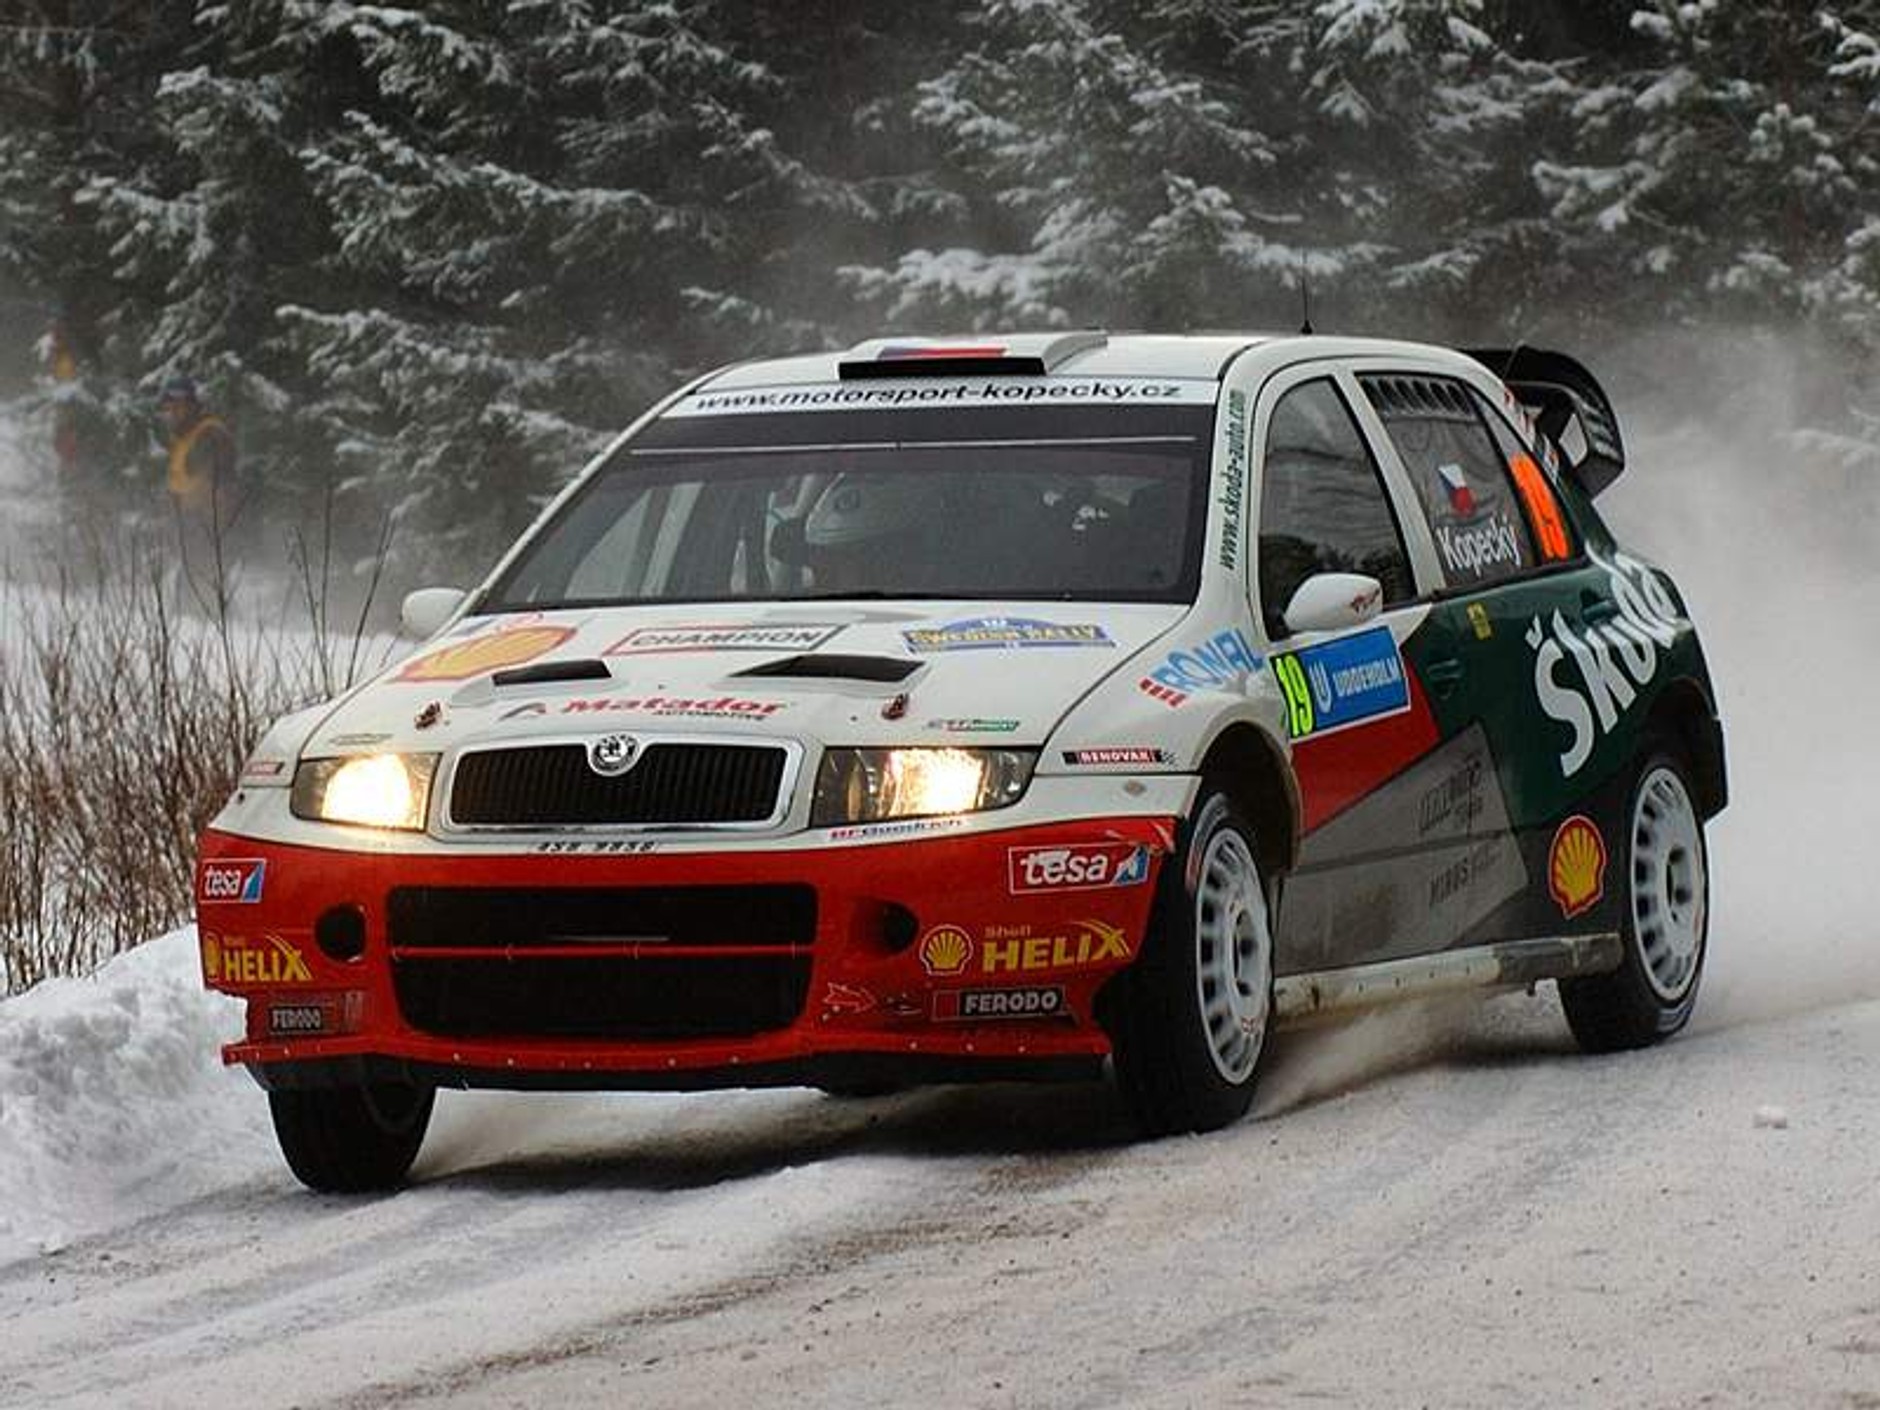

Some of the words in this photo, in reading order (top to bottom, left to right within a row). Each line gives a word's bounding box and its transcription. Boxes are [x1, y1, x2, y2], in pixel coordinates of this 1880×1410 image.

[696, 381, 1182, 410] www.motorsport-kopecky.cz
[632, 631, 821, 647] CHAMPION
[562, 698, 787, 715] Matador
[1275, 652, 1315, 737] 19
[203, 865, 242, 897] tesa
[1019, 849, 1110, 886] tesa
[224, 938, 313, 982] HELIX
[981, 921, 1131, 973] HELIX
[963, 990, 1060, 1016] FERODO
